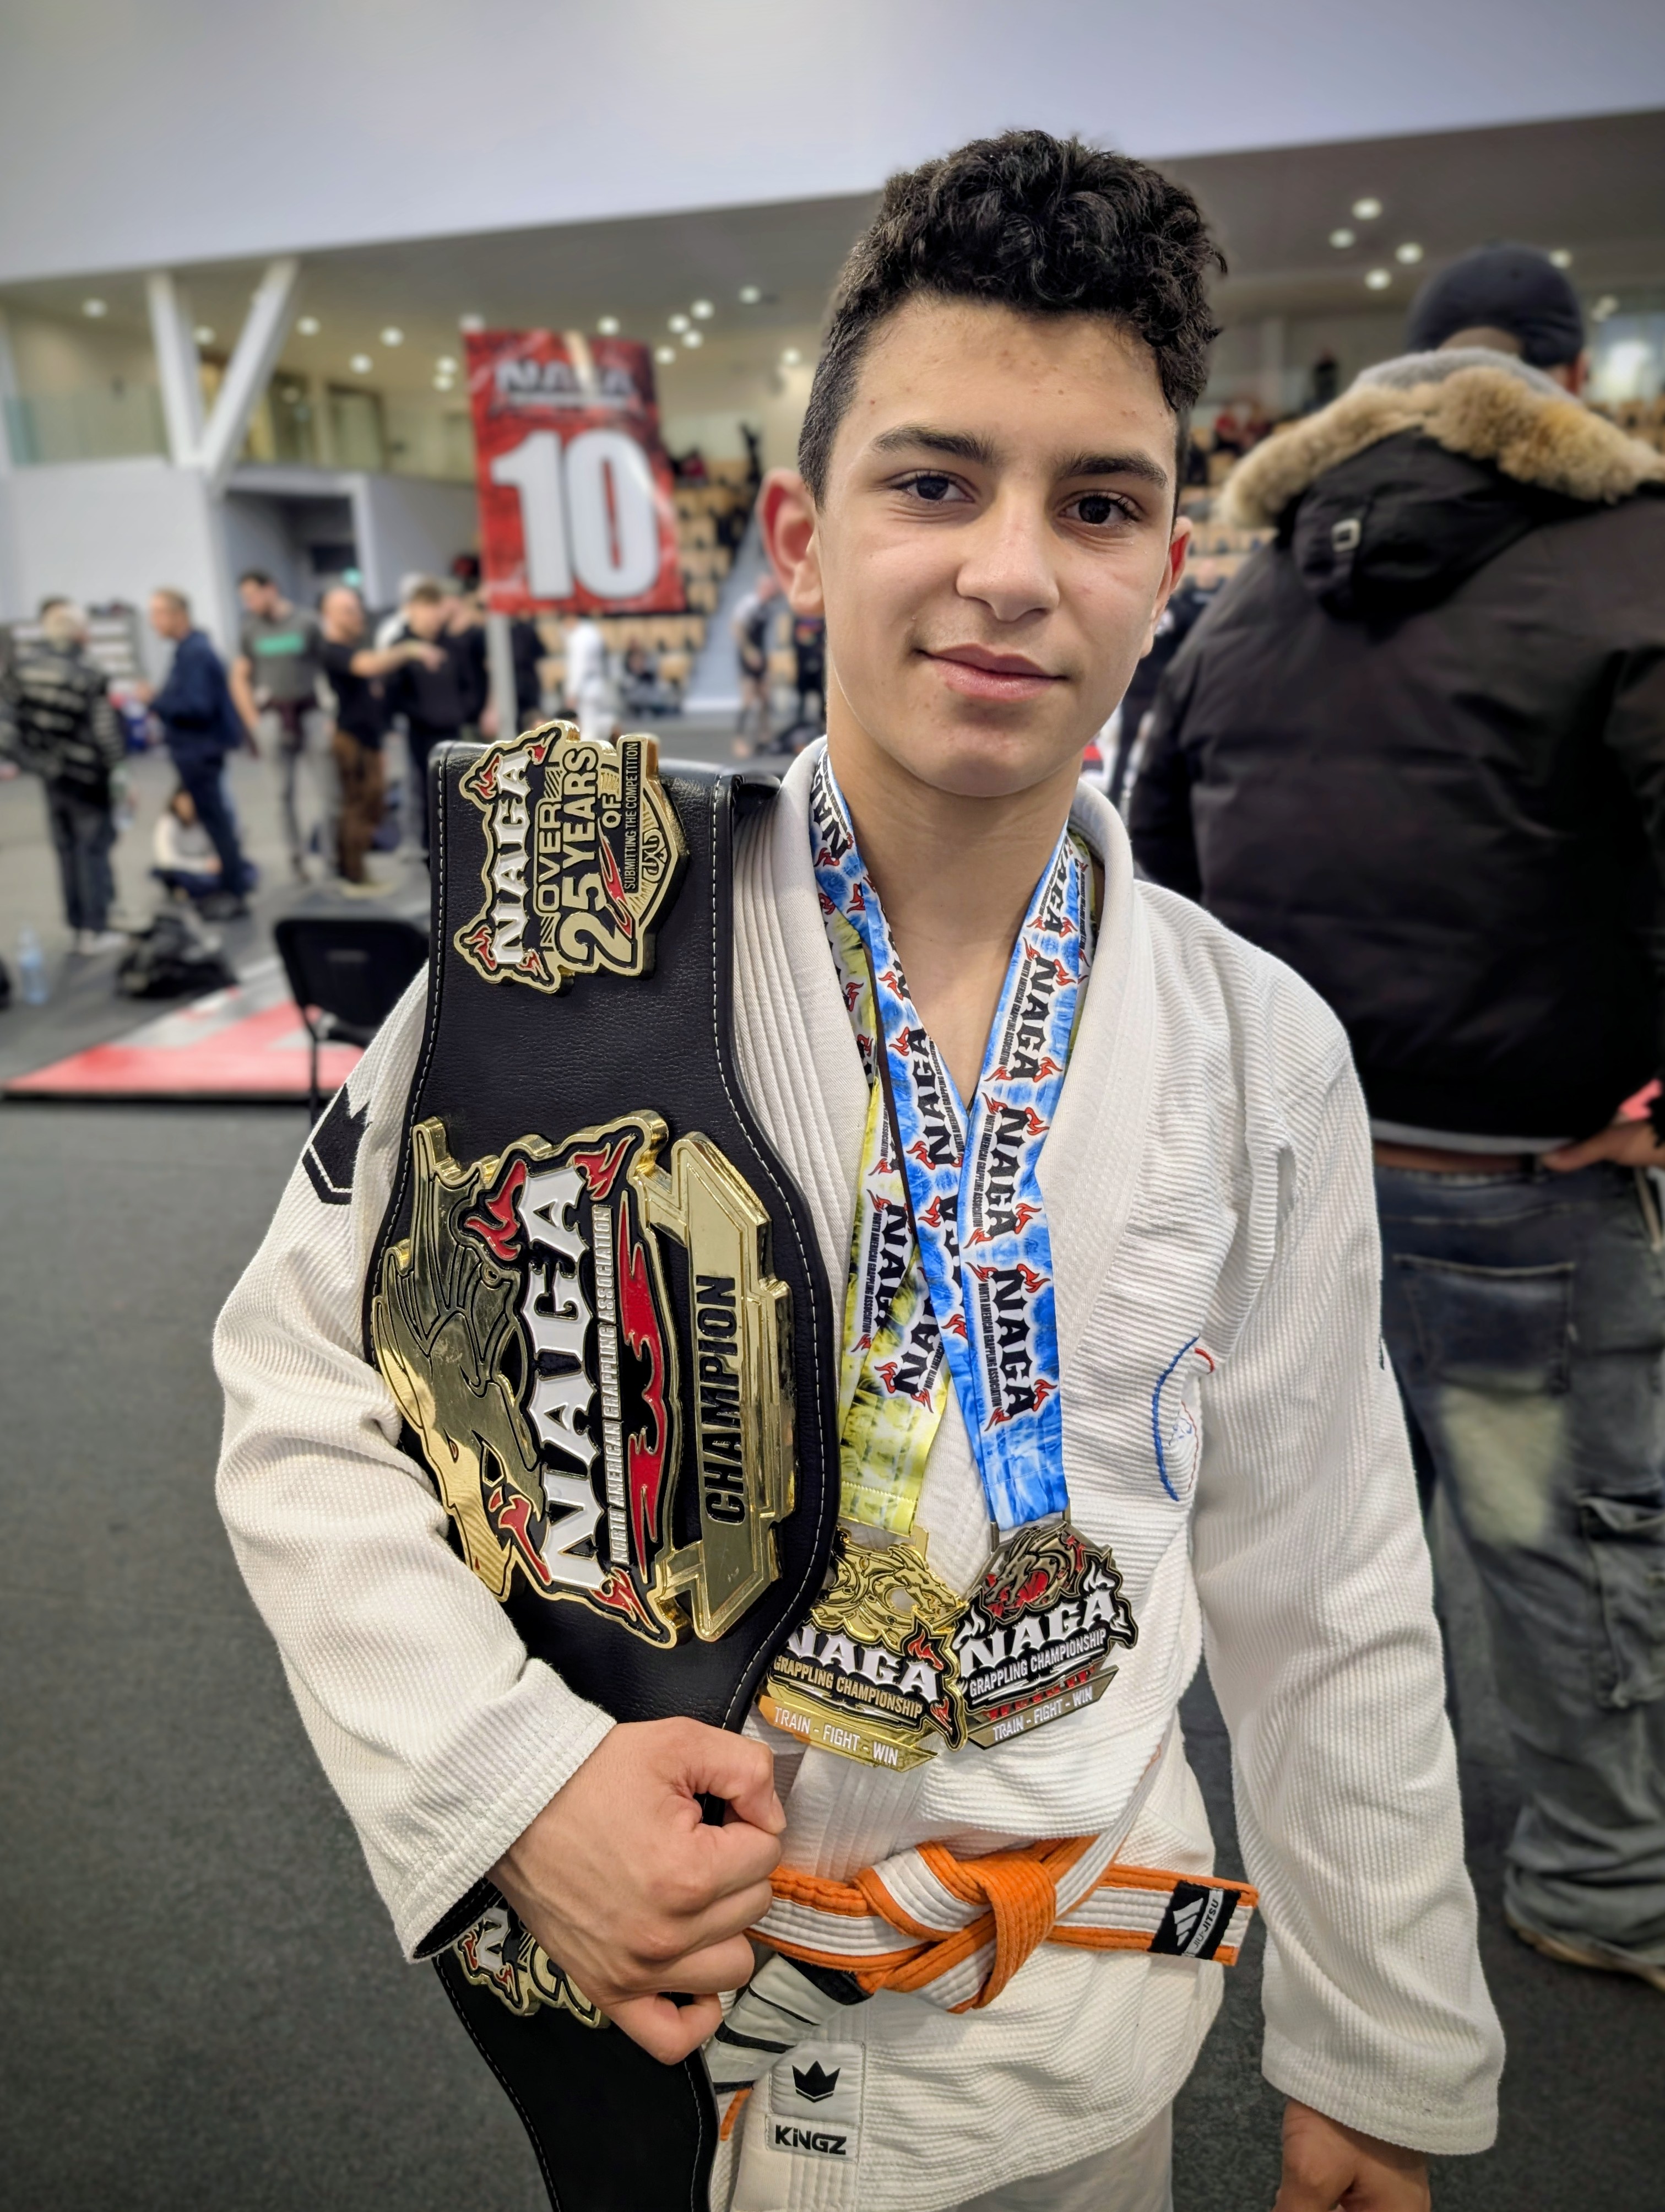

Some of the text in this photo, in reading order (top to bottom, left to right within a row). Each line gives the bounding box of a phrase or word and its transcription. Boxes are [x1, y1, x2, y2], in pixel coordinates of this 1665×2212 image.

[497, 358, 636, 396] NAA
[490, 430, 661, 601] 10
[493, 750, 532, 964] NAGA
[538, 802, 561, 912] OVER
[560, 748, 632, 962] 25 YEARS
[602, 793, 621, 828] OF
[624, 743, 638, 890] SUBMITTING THE COMPETITION
[929, 1040, 942, 1075] ASSOCIATION
[999, 960, 1032, 1067] NORTH AMERICAN GRAPPLING ASSOCIATION
[1009, 956, 1058, 1078] NAGA
[880, 1120, 890, 1158] ASSOCIATION
[908, 1027, 952, 1165] NAGA
[937, 1074, 951, 1106] GRAPPLING
[946, 1106, 963, 1138] AMERICAN
[972, 1114, 996, 1227] NORTH AMERICAN GRAPPLING ASSOCIATION
[985, 1108, 1029, 1237] NAGA
[862, 1212, 882, 1333] NORTH AMERICAN GRAPPLING ASSOCIATION
[518, 1168, 605, 1589] NAGA
[594, 1207, 629, 1564] NORTH AMERICAN GRAPPLING ASSOCIATION
[923, 1367, 937, 1390] NORTH
[978, 1283, 1002, 1408] NORTH AMERICAN GRAPPLING ASSOCIATION
[990, 1269, 1036, 1418] NAGA
[696, 1275, 746, 1525] CHAMPION
[773, 1655, 923, 1719] GRAPPLING CHAMPIONSHIP
[959, 1589, 1116, 1679] NAGA
[969, 1627, 1107, 1697] GRAPPLING CHAMPIONSHIP
[774, 1706, 811, 1734] TRAIN
[823, 1724, 861, 1751] FIGHT
[872, 1740, 899, 1766] WIN
[993, 1717, 1023, 1741] TRAIN
[1033, 1699, 1063, 1724] FIGHT
[1072, 1685, 1093, 1707] WIN
[1192, 1899, 1219, 1949] JIU-JITSU
